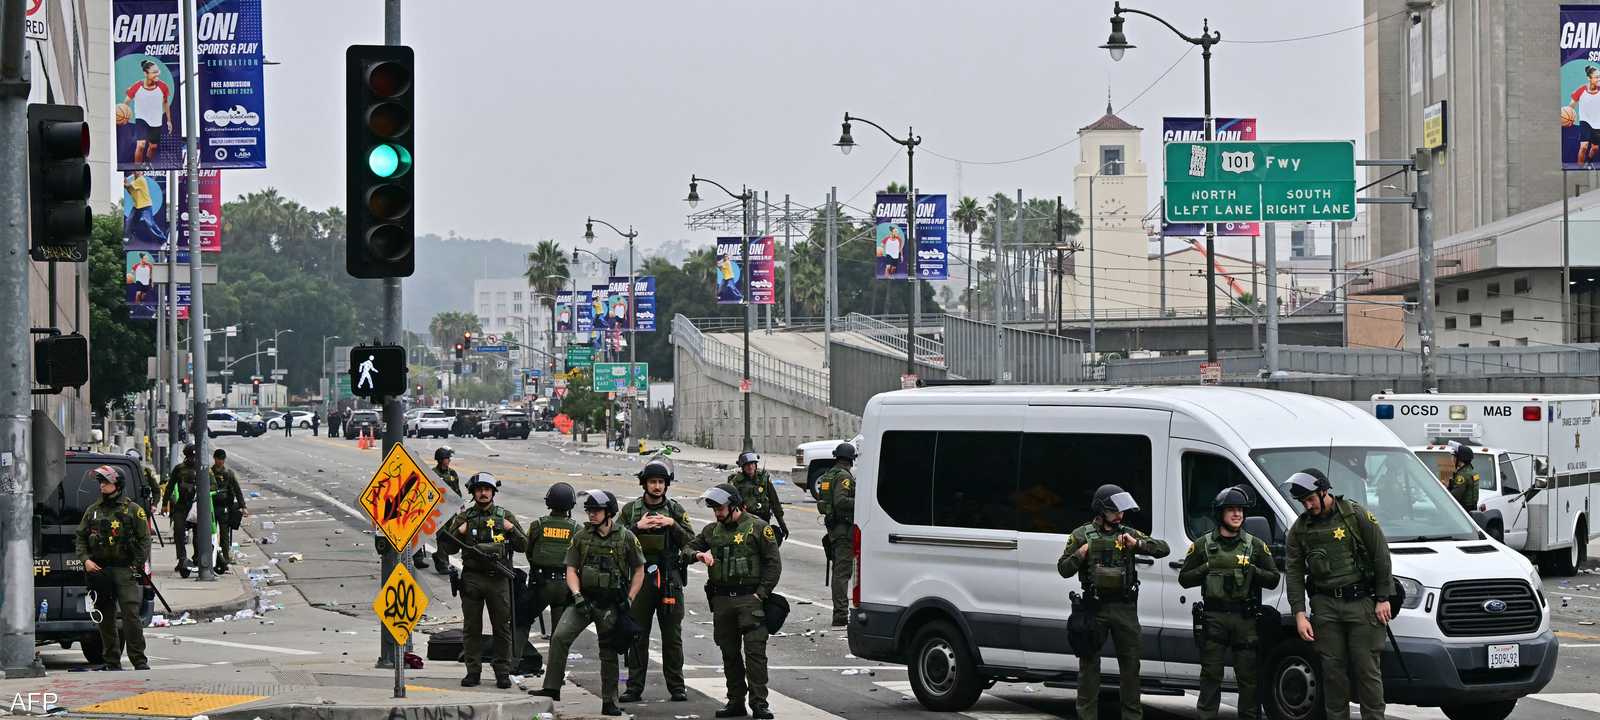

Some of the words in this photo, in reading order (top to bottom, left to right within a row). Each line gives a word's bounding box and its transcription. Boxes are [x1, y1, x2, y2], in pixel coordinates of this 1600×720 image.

[25, 19, 45, 34] RED
[113, 13, 178, 43] GAME
[198, 12, 238, 41] ON!
[144, 44, 180, 56] SCIENCE,
[197, 43, 228, 55] SPORTS
[229, 43, 236, 54] &
[237, 43, 258, 54] PLAY
[207, 59, 258, 67] EXHIBITION
[1227, 156, 1249, 168] 101
[1265, 156, 1301, 171] Fwy
[1191, 190, 1237, 200] NORTH
[1286, 189, 1332, 199] SOUTH
[876, 203, 908, 217] GAME
[916, 203, 936, 217] ON!
[1174, 206, 1209, 215] LEFT
[1215, 205, 1254, 215] LANE
[1266, 205, 1307, 214] RIGHT
[1312, 204, 1351, 214] LANE
[717, 243, 743, 255] GAME
[749, 243, 765, 255] ON!
[608, 282, 630, 292] GAME
[635, 282, 648, 291] ON!
[1400, 404, 1439, 416] OCSD
[1483, 405, 1512, 416] MAB
